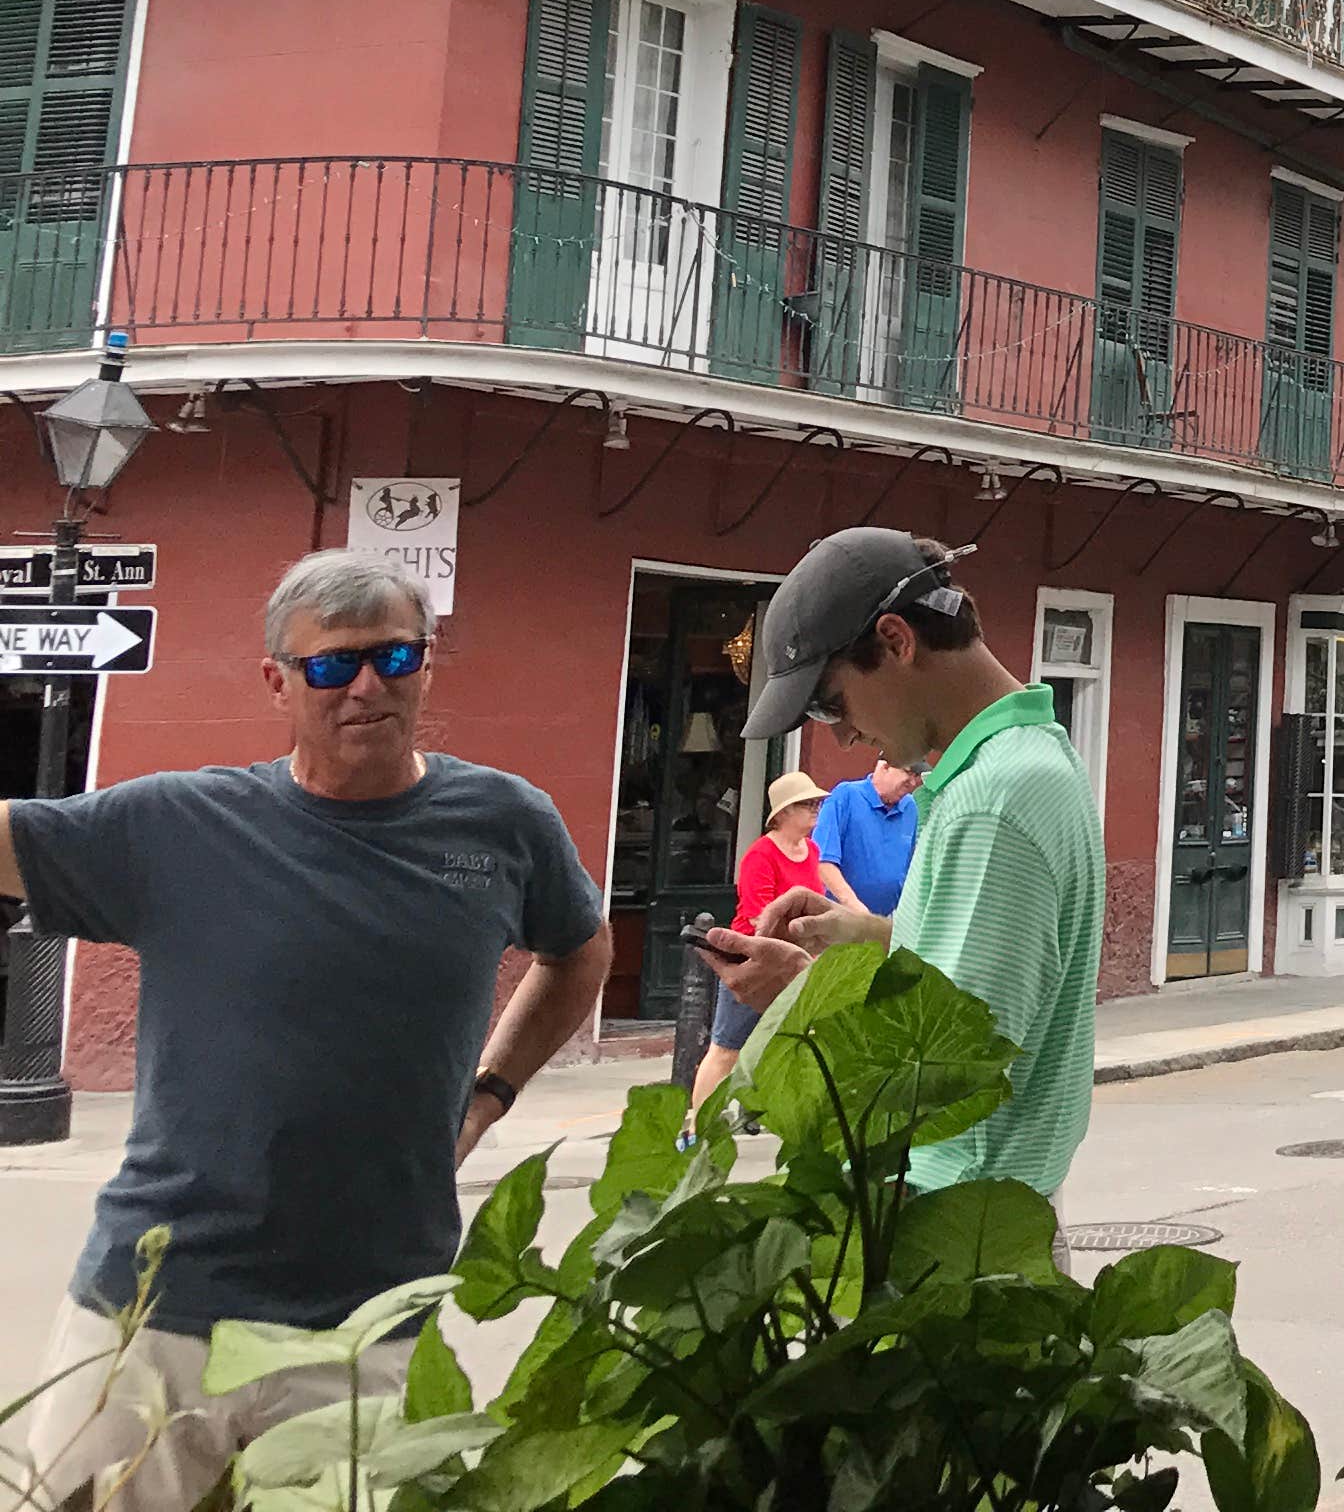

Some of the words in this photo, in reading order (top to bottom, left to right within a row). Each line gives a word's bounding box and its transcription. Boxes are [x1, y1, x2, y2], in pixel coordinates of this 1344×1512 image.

[82, 560, 105, 581] St.
[111, 560, 145, 580] Ann
[0, 628, 27, 651] NE
[39, 628, 92, 651] WAY
